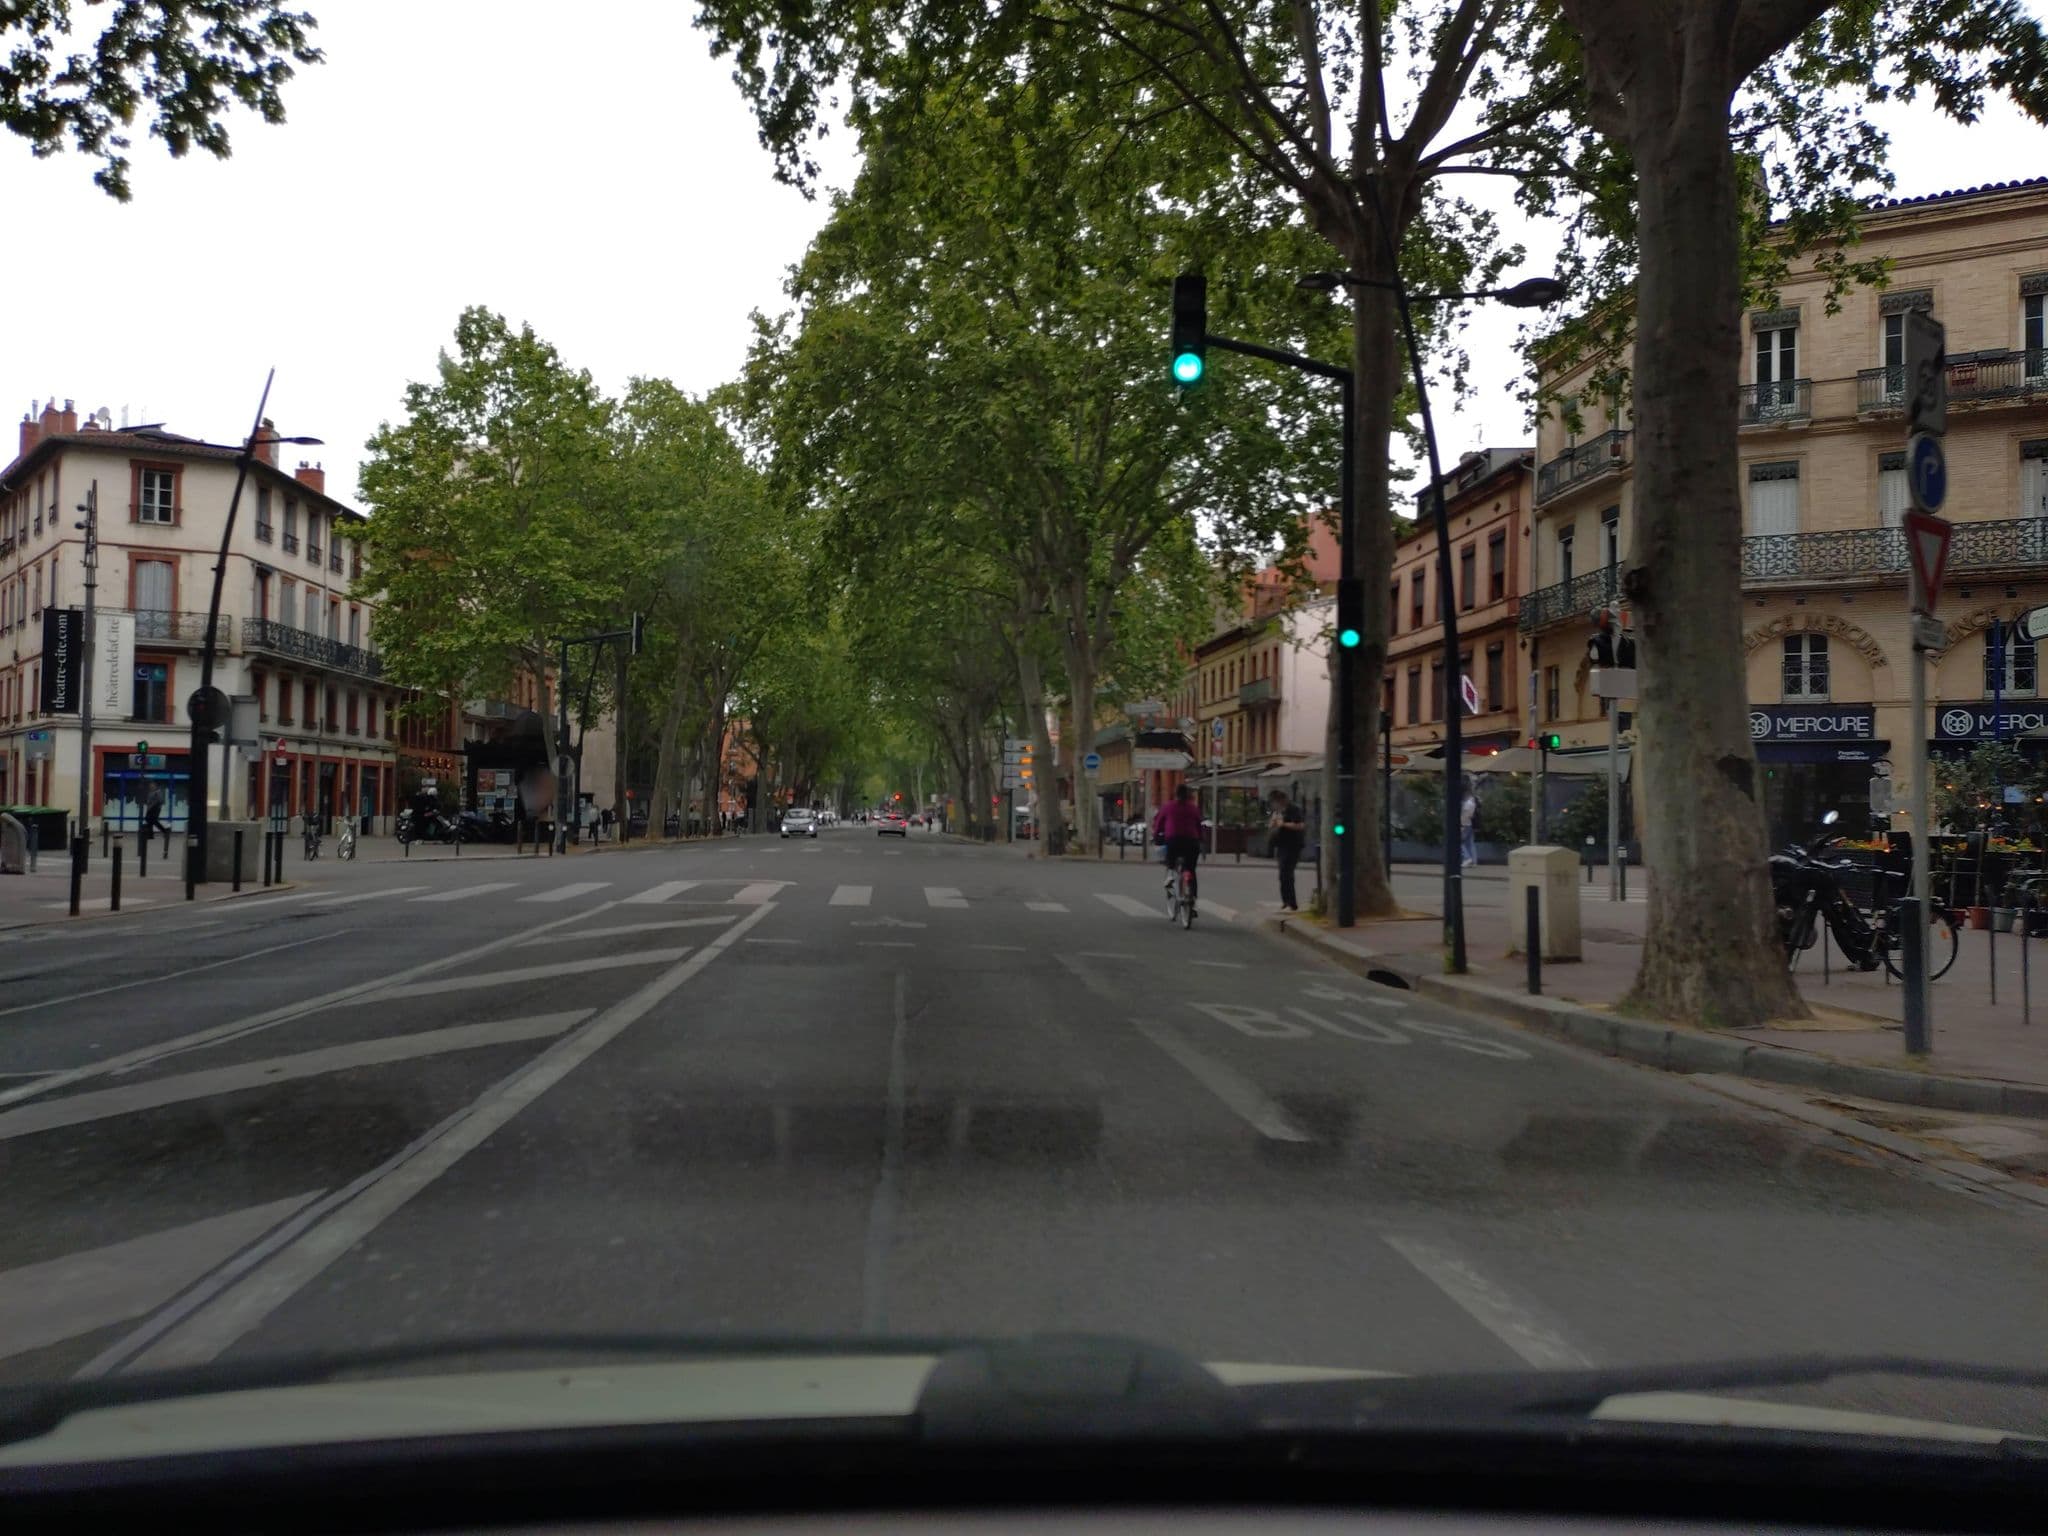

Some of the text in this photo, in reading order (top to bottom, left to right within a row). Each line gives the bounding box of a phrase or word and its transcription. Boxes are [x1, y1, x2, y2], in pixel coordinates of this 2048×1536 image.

[52, 614, 68, 709] theatre-cite.com
[1806, 615, 1888, 670] MERCURE
[1776, 716, 1870, 732] MERCURE
[1187, 1001, 1533, 1060] BUS
